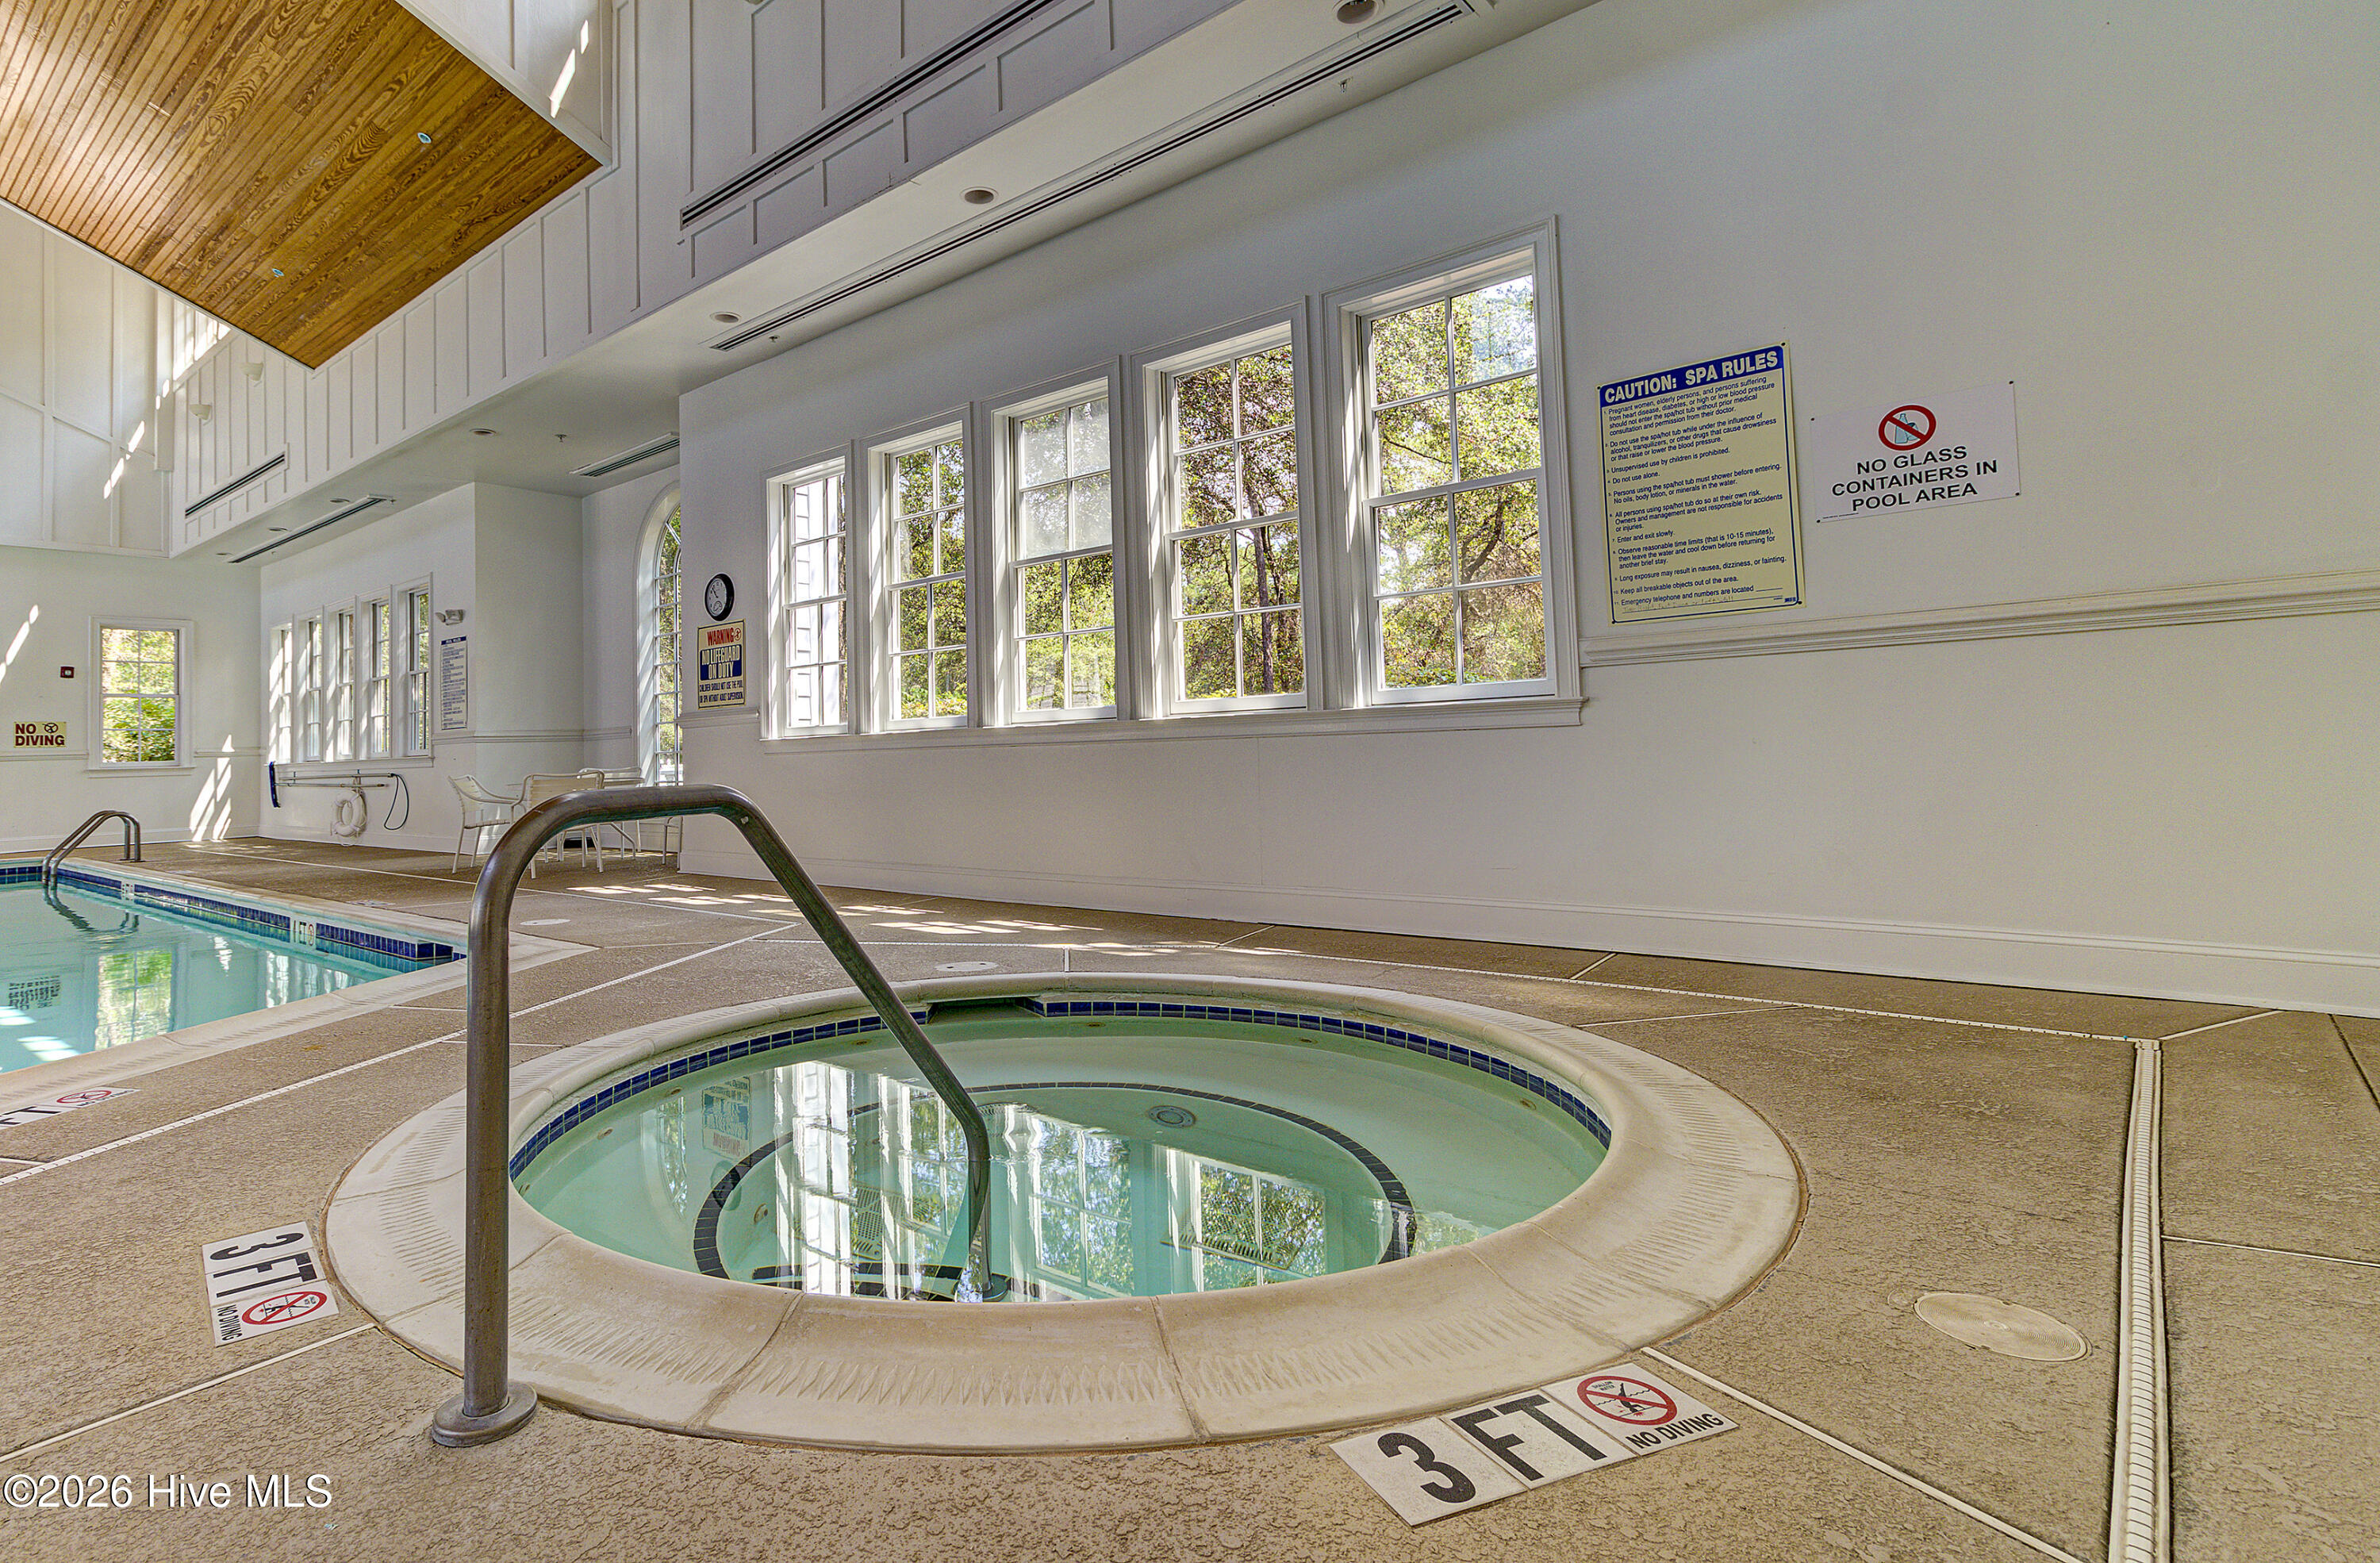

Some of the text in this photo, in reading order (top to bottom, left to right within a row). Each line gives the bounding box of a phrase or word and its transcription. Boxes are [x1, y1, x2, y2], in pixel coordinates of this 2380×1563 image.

[1604, 351, 1778, 403] CAUTION: SPA RULES
[1607, 403, 1633, 415] Pregnant
[1656, 395, 1676, 405] elderly
[1702, 386, 1714, 395] and
[1714, 382, 1739, 394] persons
[1739, 376, 1767, 387] suffering
[1609, 424, 1642, 436] consultation
[1642, 421, 1654, 429] and
[1654, 416, 1686, 428] permission
[1700, 409, 1714, 418] their
[1649, 429, 1671, 441] spa/hot
[1681, 425, 1698, 434] while
[1698, 422, 1716, 431] under
[1726, 414, 1755, 425] influence
[1617, 452, 1629, 461] that
[1677, 440, 1695, 450] blood
[1856, 446, 1967, 475] NO GLASS
[1610, 460, 1649, 474] Unsupervised
[1668, 454, 1692, 463] children
[1612, 489, 1636, 497] Persons
[1662, 478, 1684, 490] spa/hot
[1695, 474, 1710, 483] must
[1710, 471, 1733, 481] shower
[1733, 468, 1753, 477] before
[1675, 484, 1700, 494] minerals
[1832, 459, 1998, 497] CONTAINERS IN
[1622, 508, 1645, 518] persons
[1662, 501, 1683, 511] spa/hot
[1718, 493, 1733, 501] their
[1852, 482, 1979, 512] POOL AREA
[1617, 547, 1641, 555] Observe
[1641, 541, 1673, 551] reasonable
[1703, 534, 1718, 543] (that
[1726, 531, 1744, 540] 10-15
[1618, 561, 1641, 570] another
[1640, 558, 1654, 566] brief
[1633, 571, 1660, 580] exposure
[1673, 566, 1691, 575] result
[1643, 582, 1672, 592] breakable
[1672, 580, 1694, 589] objects
[1652, 593, 1681, 602] telephone
[1730, 584, 1754, 593] located
[707, 627, 734, 647] WARNING
[701, 645, 740, 666] NO LIFEGUARD
[708, 661, 734, 680] ON DUTY
[15, 723, 36, 735] NO
[15, 735, 65, 747] DIVING
[209, 1232, 317, 1298] 3 FT
[217, 1304, 243, 1342] NO DIVING
[1626, 1413, 1725, 1450] NO DIVING
[1377, 1394, 1608, 1503] 3 FT
